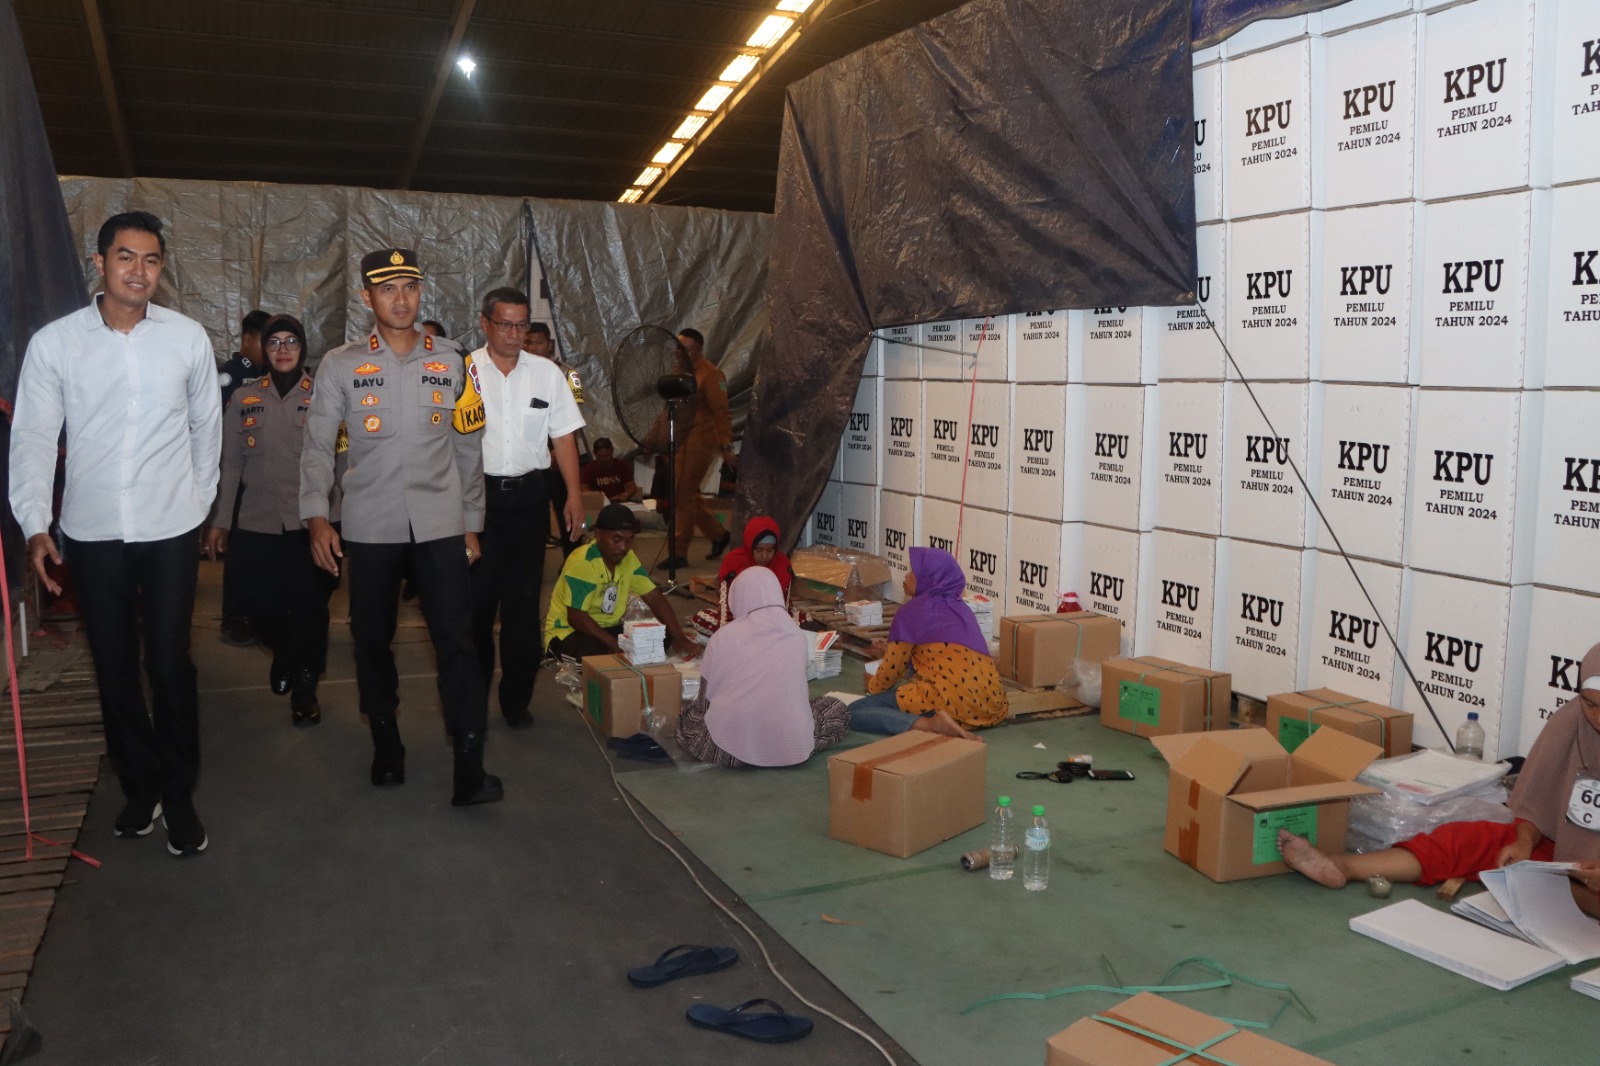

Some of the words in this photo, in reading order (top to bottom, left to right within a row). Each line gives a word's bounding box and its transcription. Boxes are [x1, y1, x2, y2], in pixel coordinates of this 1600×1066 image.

[1444, 58, 1506, 103] KPU
[1343, 80, 1395, 120] KPU
[1572, 100, 1600, 115] TAH
[1246, 100, 1291, 136] KPU
[1452, 102, 1497, 120] PEMILU
[1350, 120, 1388, 135] PEMILU
[1437, 121, 1477, 138] TAHUN
[1482, 115, 1512, 130] 2024
[1252, 136, 1286, 151] PEMILU
[1338, 138, 1371, 151] TAHUN
[1376, 132, 1400, 145] 2024
[1241, 152, 1271, 166] TAHUN
[1275, 148, 1297, 159] 2024
[1340, 265, 1392, 296] KPU
[1442, 259, 1504, 294] KPU
[1247, 270, 1292, 300] KPU
[1252, 305, 1286, 315] PEMILU
[1346, 303, 1384, 312] PEMILU
[1450, 300, 1494, 311] PEMILU
[1176, 310, 1206, 319] PEMILU
[1334, 317, 1368, 326] TAHUN
[1372, 317, 1396, 326] 2024
[1435, 316, 1474, 326] TAHUN
[1479, 316, 1508, 326] 2024
[1564, 310, 1600, 322] TAHU
[1030, 321, 1052, 329] PEMILU
[1098, 320, 1124, 328] PEMILU
[1168, 322, 1193, 331] TAHUN
[1196, 320, 1215, 330] 2024
[1242, 319, 1272, 328] TAHUN
[1275, 318, 1297, 326] 2024
[354, 378, 384, 388] BAYU
[422, 376, 452, 387] POLRI
[849, 414, 869, 431] KPU
[890, 417, 913, 436] KPU
[934, 420, 958, 440] KPU
[972, 424, 999, 447] KPU
[1024, 429, 1053, 452] KPU
[1095, 433, 1128, 459] KPU
[1169, 432, 1207, 459] KPU
[1246, 436, 1290, 464] KPU
[932, 453, 946, 461] TAHUN
[974, 450, 994, 459] PEMILU
[1027, 456, 1048, 465] PEMILU
[1338, 441, 1390, 473] KPU
[968, 460, 986, 468] TAHUN
[1020, 466, 1039, 475] TAHUN
[1042, 469, 1056, 477] 2024
[1099, 462, 1124, 472] PEMILU
[1174, 463, 1202, 473] PEMILU
[1433, 450, 1493, 485] KPU
[1091, 472, 1113, 482] TAHUN
[1115, 476, 1131, 484] 2024
[1165, 474, 1190, 484] TAHUN
[1192, 477, 1211, 486] 2024
[1251, 469, 1283, 480] PEMILU
[1241, 480, 1269, 491] TAHUN
[1272, 484, 1293, 494] 2024
[1344, 477, 1381, 490] PEMILU
[1332, 489, 1364, 501] TAHUN
[1368, 494, 1392, 505] 2024
[1440, 490, 1483, 503] PEMILU
[1426, 502, 1464, 516] TAHUN
[1468, 508, 1497, 520] 2024
[1570, 500, 1600, 513] PEM
[817, 512, 835, 532] KPU
[848, 518, 868, 538] KPU
[886, 528, 906, 551] KPU
[929, 536, 953, 555] KPU
[970, 548, 996, 575] KPU
[972, 576, 992, 587] PEMILU
[1020, 560, 1048, 588] KPU
[966, 582, 984, 594] TAHUN
[985, 588, 999, 598] 2024
[1023, 588, 1043, 600] PEMILU
[1090, 572, 1124, 601] KPU
[1162, 580, 1199, 611] KPU
[1016, 596, 1034, 608] TAHUN
[1036, 602, 1050, 612] 2024
[1094, 602, 1118, 614] PEMILU
[1241, 593, 1284, 627] KPU
[1166, 611, 1194, 625] PEMILU
[1157, 620, 1182, 634] TAHUN
[1184, 628, 1202, 639] 2024
[1246, 626, 1276, 641] PEMILU
[1329, 610, 1379, 649] KPU
[1236, 636, 1263, 650] TAHUN
[1266, 644, 1286, 656] 2024
[1425, 631, 1483, 672] KPU
[1334, 646, 1370, 664] PEMILU
[1322, 656, 1354, 672] TAHUN
[1357, 667, 1380, 681] 2024
[1431, 670, 1473, 689] PEMILU
[1417, 680, 1455, 699] TAHUN
[1458, 692, 1485, 707] 2024
[1583, 812, 1592, 824] C
